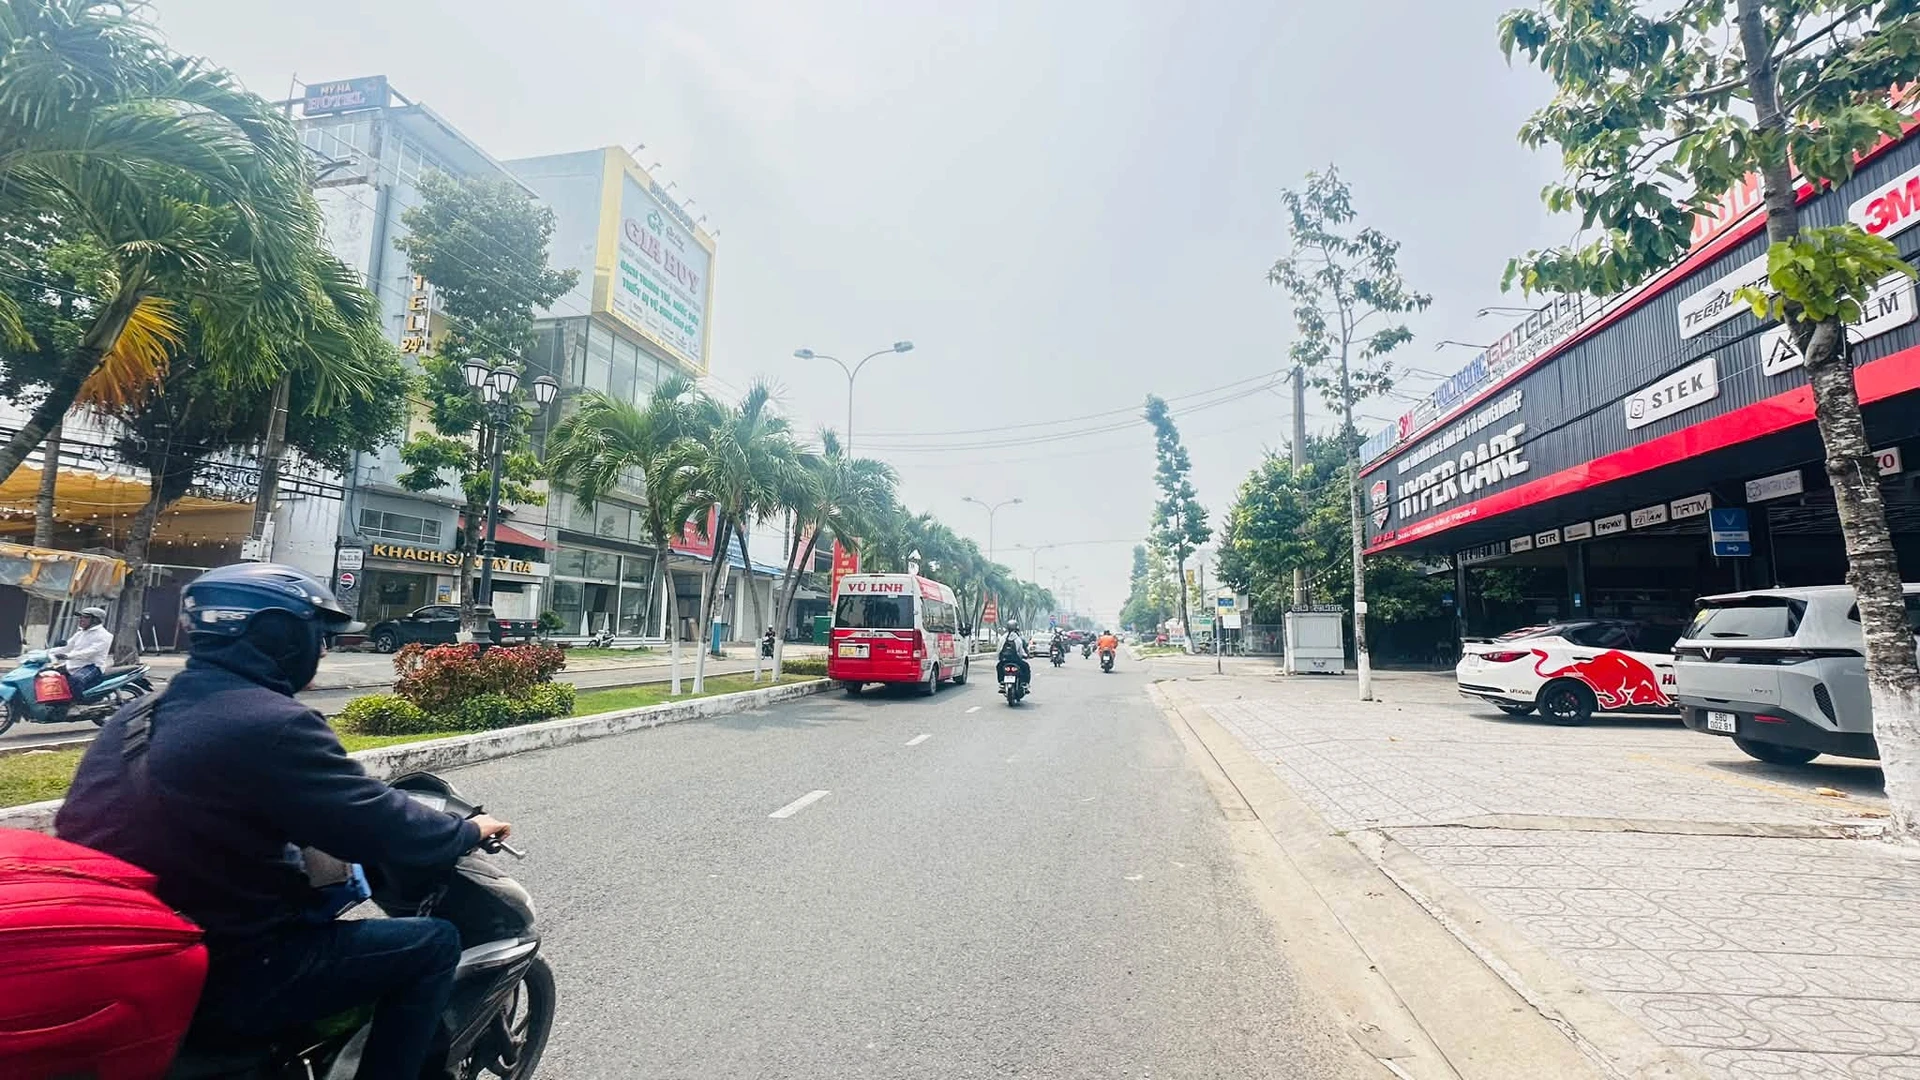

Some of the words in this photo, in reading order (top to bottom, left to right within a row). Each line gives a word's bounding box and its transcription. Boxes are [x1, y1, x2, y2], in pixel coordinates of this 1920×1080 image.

[1865, 176, 1920, 234] 3M
[1652, 373, 1704, 409] STEK
[1398, 460, 1458, 520] HYPER
[1459, 423, 1529, 495] CARE
[1538, 533, 1557, 545] GTR
[871, 583, 904, 593] LINH
